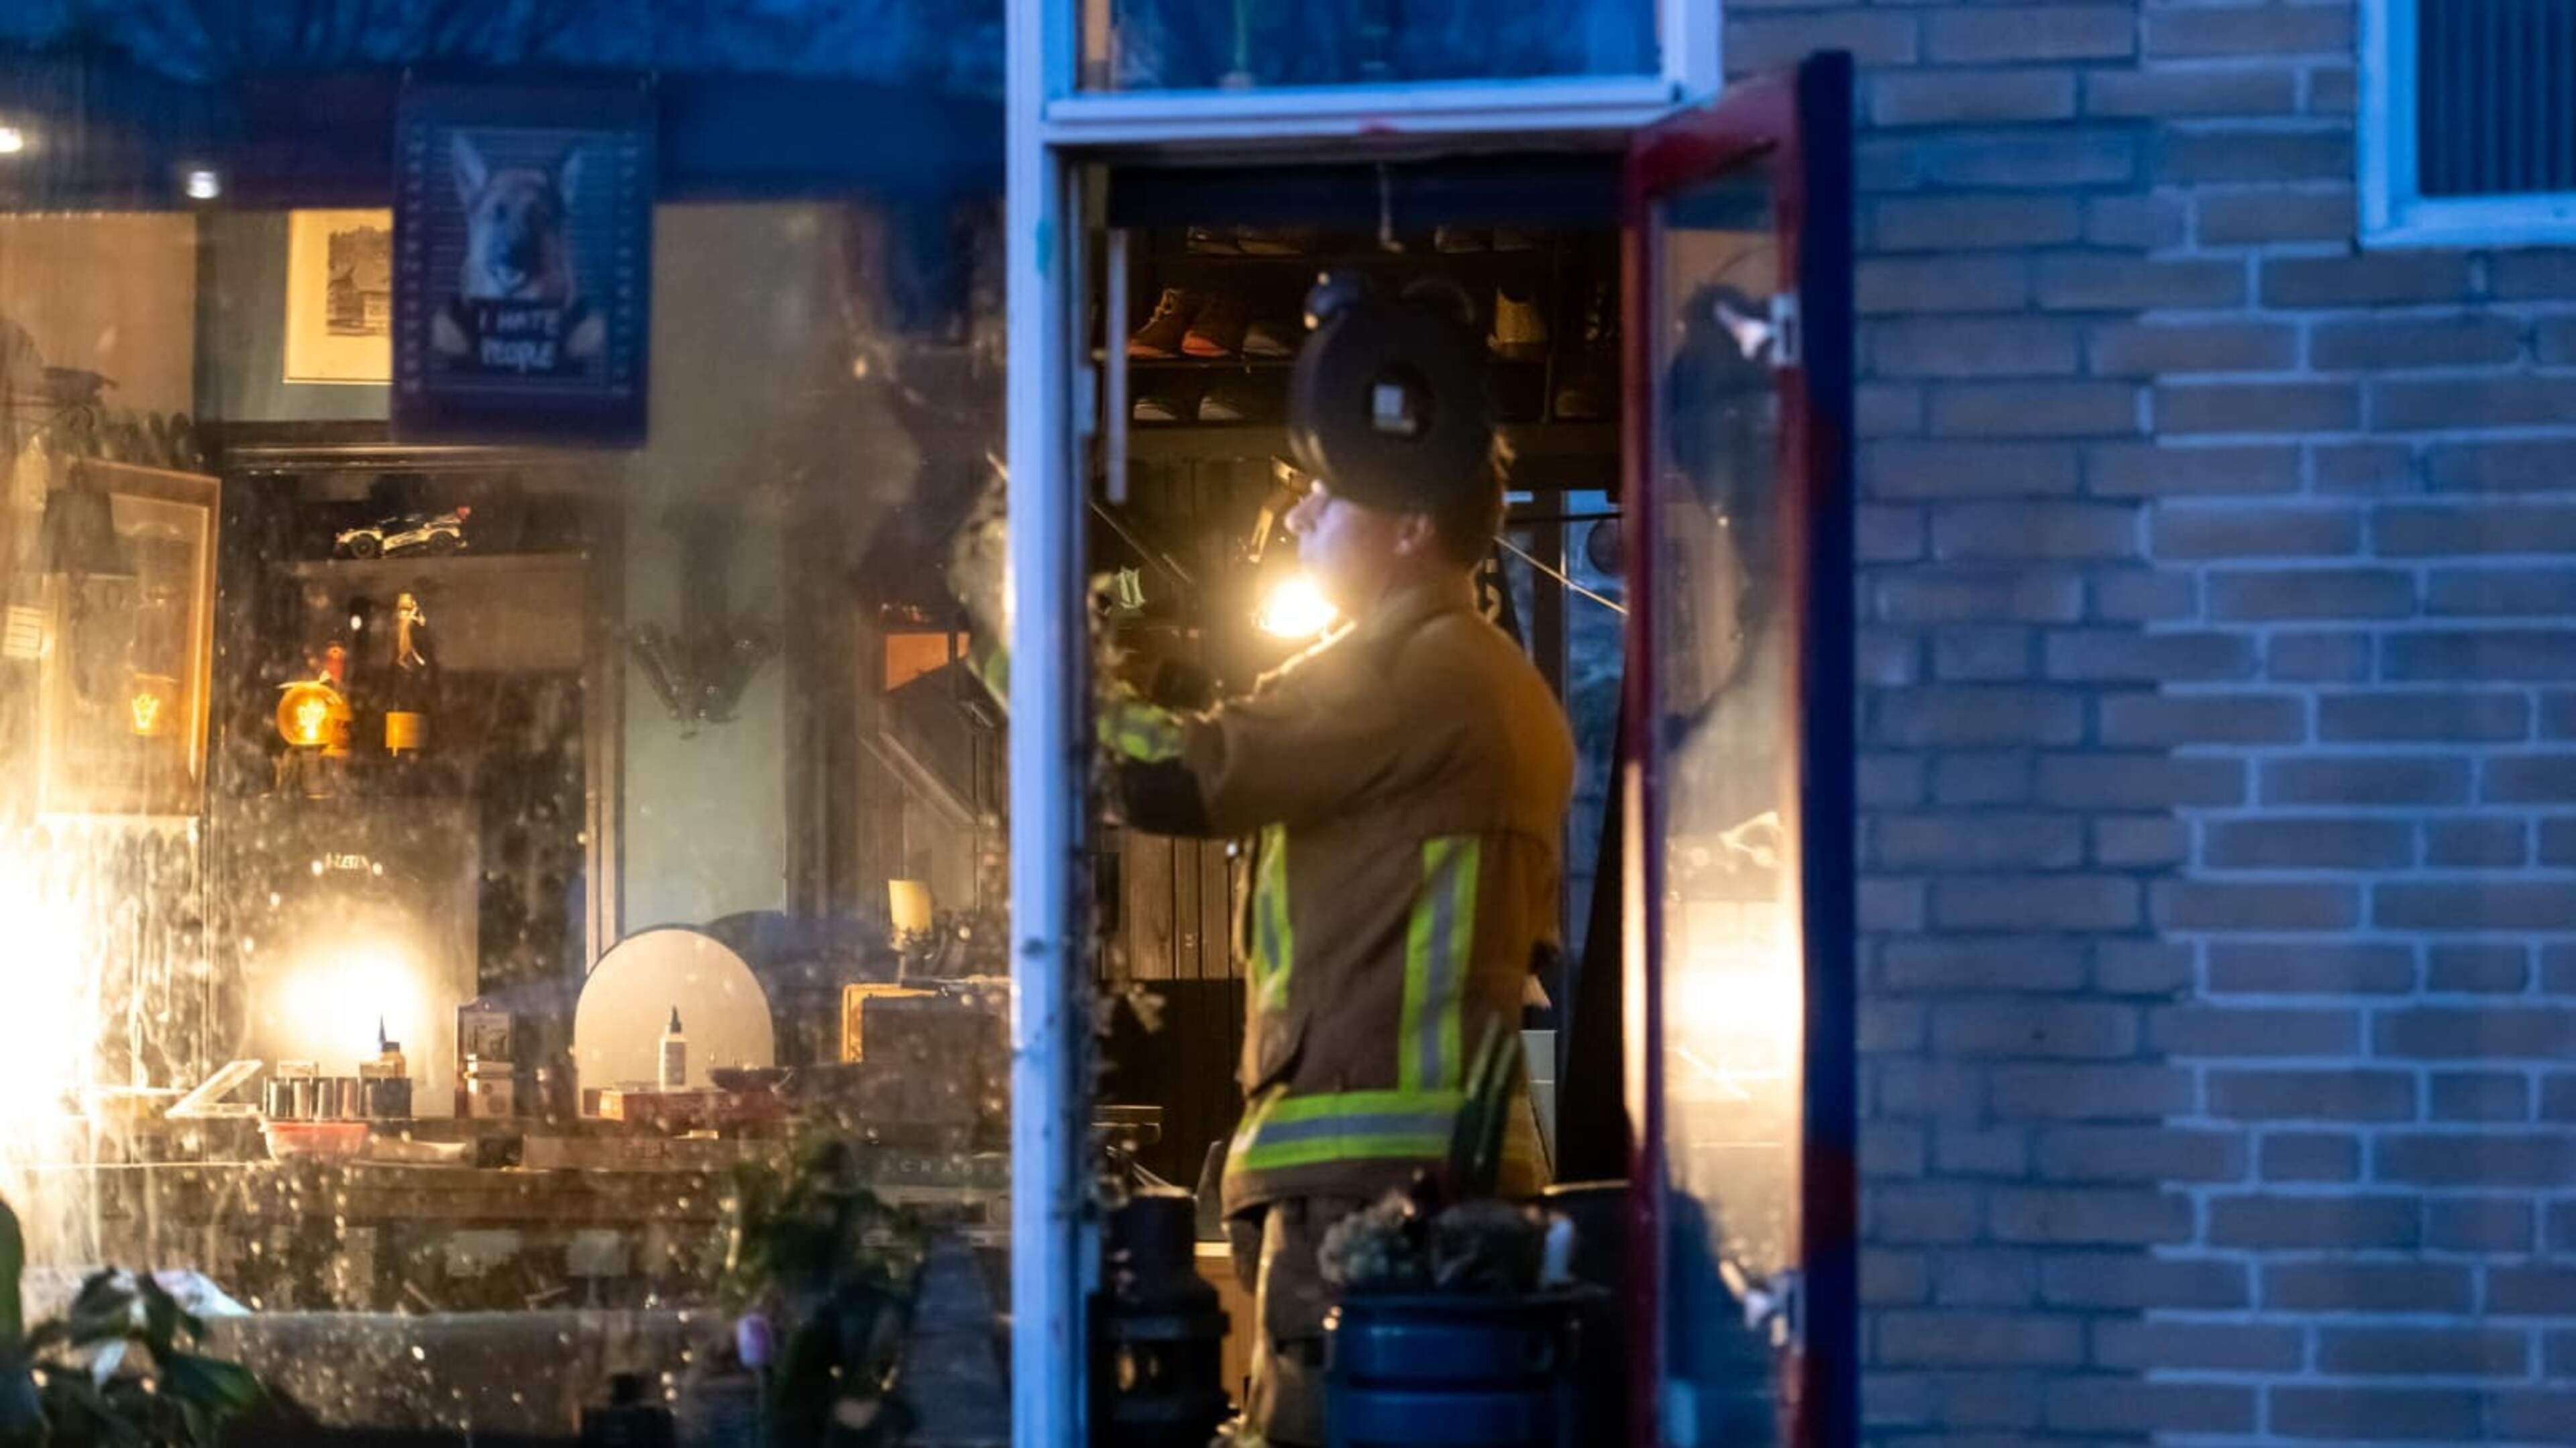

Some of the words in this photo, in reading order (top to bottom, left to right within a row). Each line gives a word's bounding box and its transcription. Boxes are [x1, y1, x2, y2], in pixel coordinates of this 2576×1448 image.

[478, 311, 488, 333] I
[496, 309, 559, 337] HATE
[481, 338, 555, 374] PEOPLE
